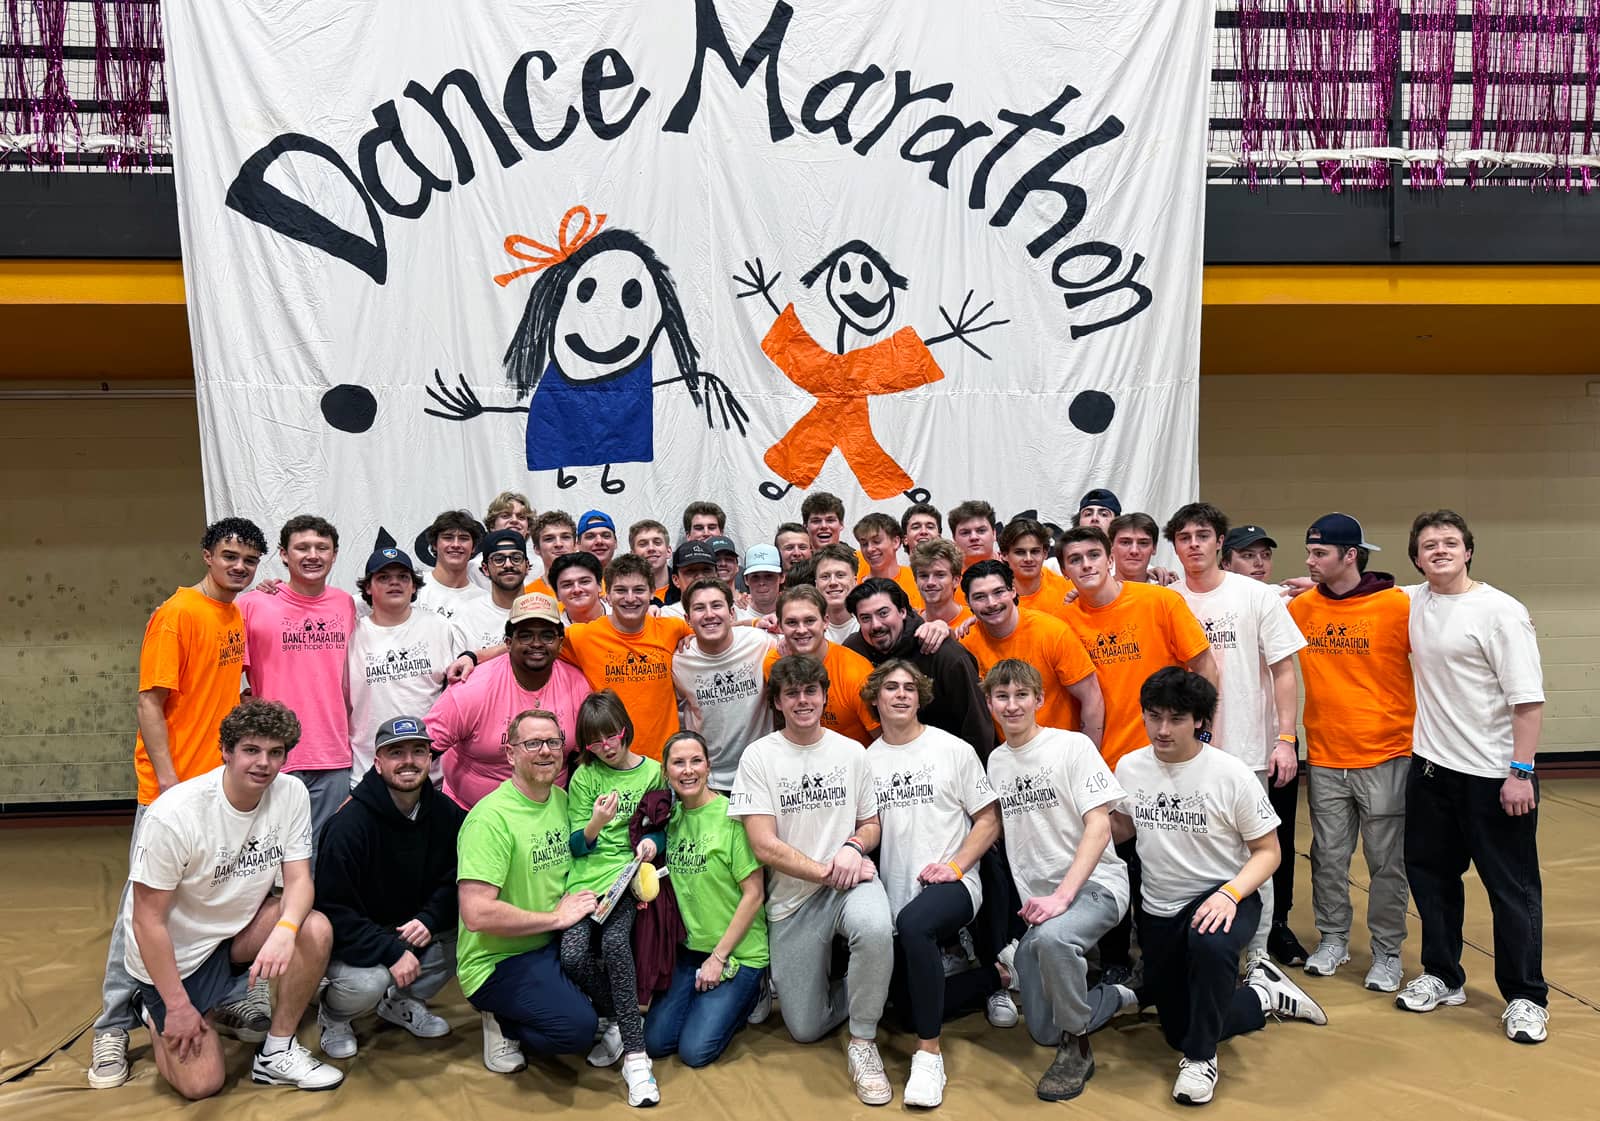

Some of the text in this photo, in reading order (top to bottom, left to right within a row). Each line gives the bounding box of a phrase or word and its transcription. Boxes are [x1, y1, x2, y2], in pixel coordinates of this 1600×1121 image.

[225, 0, 1153, 341] Dance Marathon
[282, 631, 345, 644] DANCE MARATHON
[1206, 631, 1236, 644] RATHON
[1307, 636, 1369, 649] DANCE MARATHON
[1107, 642, 1144, 658] MARATHON
[366, 658, 432, 678] DANCE MARATHON
[606, 662, 668, 676] DANCE MARATHON
[366, 676, 386, 686] giving
[390, 673, 408, 681] hope
[696, 678, 757, 700] DANCE MARATHON
[780, 786, 846, 808] DANCE MARATHON
[896, 784, 934, 801] MARATHON
[780, 806, 801, 816] giving
[802, 802, 821, 811] hope
[824, 800, 832, 808] to
[893, 800, 911, 808] hope
[1000, 793, 1023, 810] DANCE
[1004, 807, 1022, 818] giving
[1136, 806, 1206, 826] DANCE MARATHON
[1156, 822, 1178, 832] hope
[1181, 824, 1189, 832] to
[1192, 826, 1208, 834] kids
[532, 847, 552, 864] DANCE
[233, 868, 256, 878] hope
[260, 864, 267, 872] to
[532, 862, 550, 874] giving
